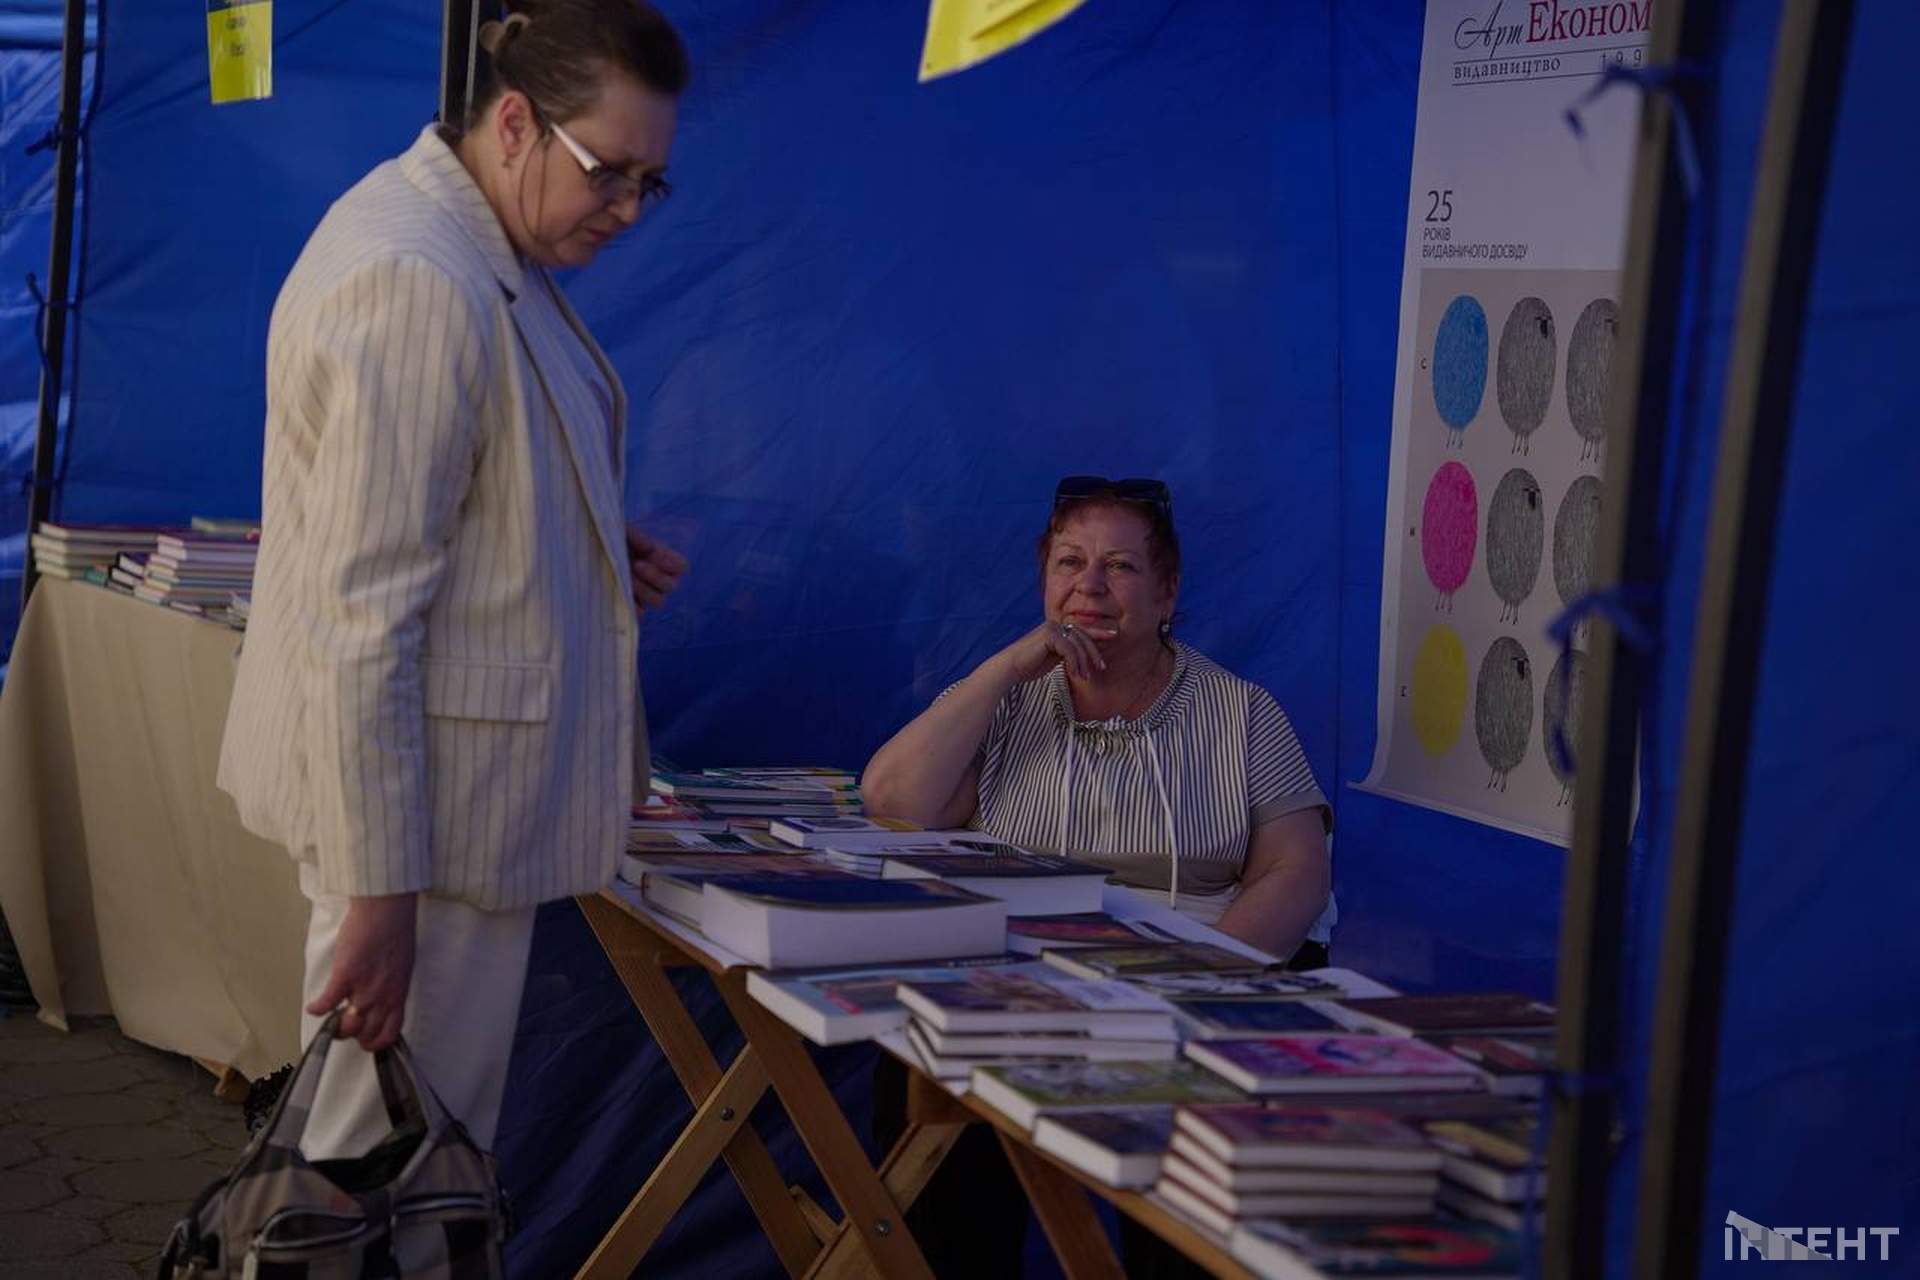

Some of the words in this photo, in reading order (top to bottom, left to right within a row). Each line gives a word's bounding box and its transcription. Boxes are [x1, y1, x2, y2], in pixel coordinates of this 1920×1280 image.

[1425, 190, 1453, 222] 25
[1423, 227, 1451, 241] РОКІВ
[1422, 244, 1488, 259] ВИДАВНИЧОГО
